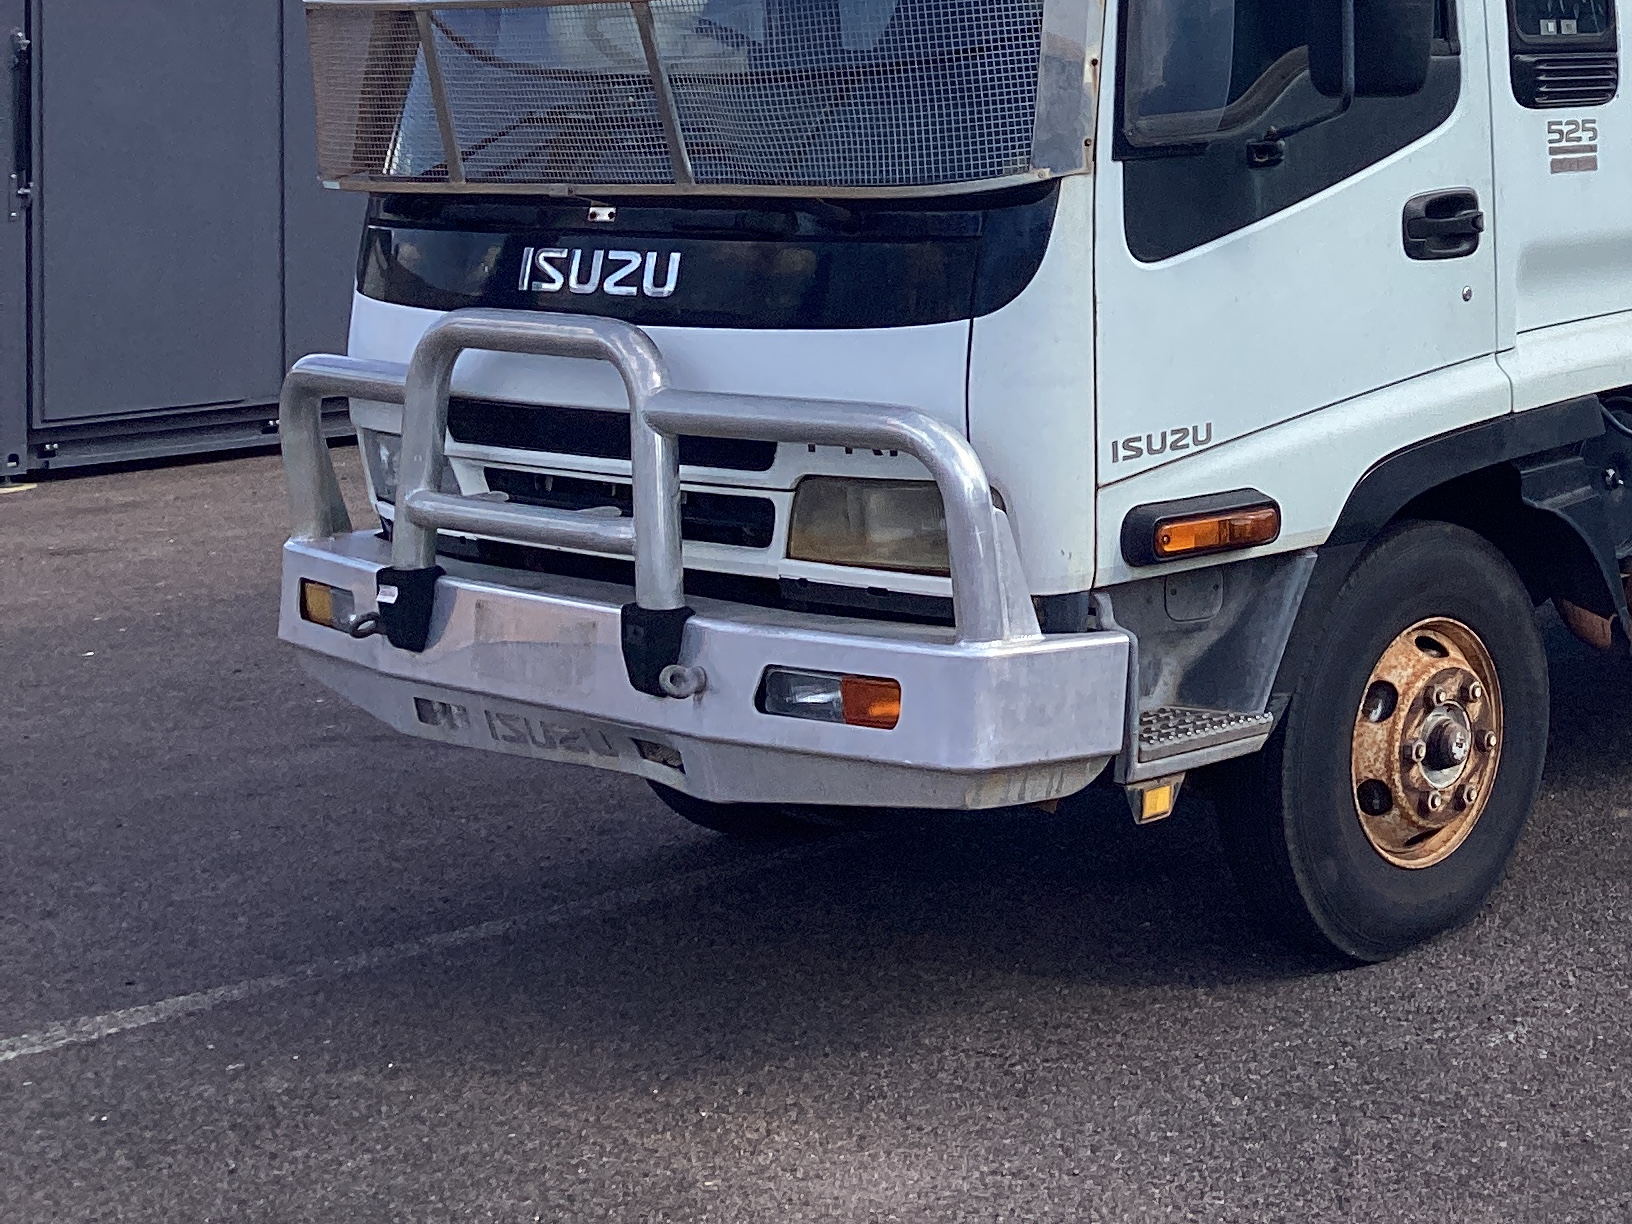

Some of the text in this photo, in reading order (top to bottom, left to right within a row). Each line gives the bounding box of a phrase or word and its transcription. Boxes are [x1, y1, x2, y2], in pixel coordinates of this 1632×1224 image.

[1547, 119, 1598, 144] 525
[518, 247, 681, 297] ISUZU
[1111, 422, 1212, 464] ISUZU
